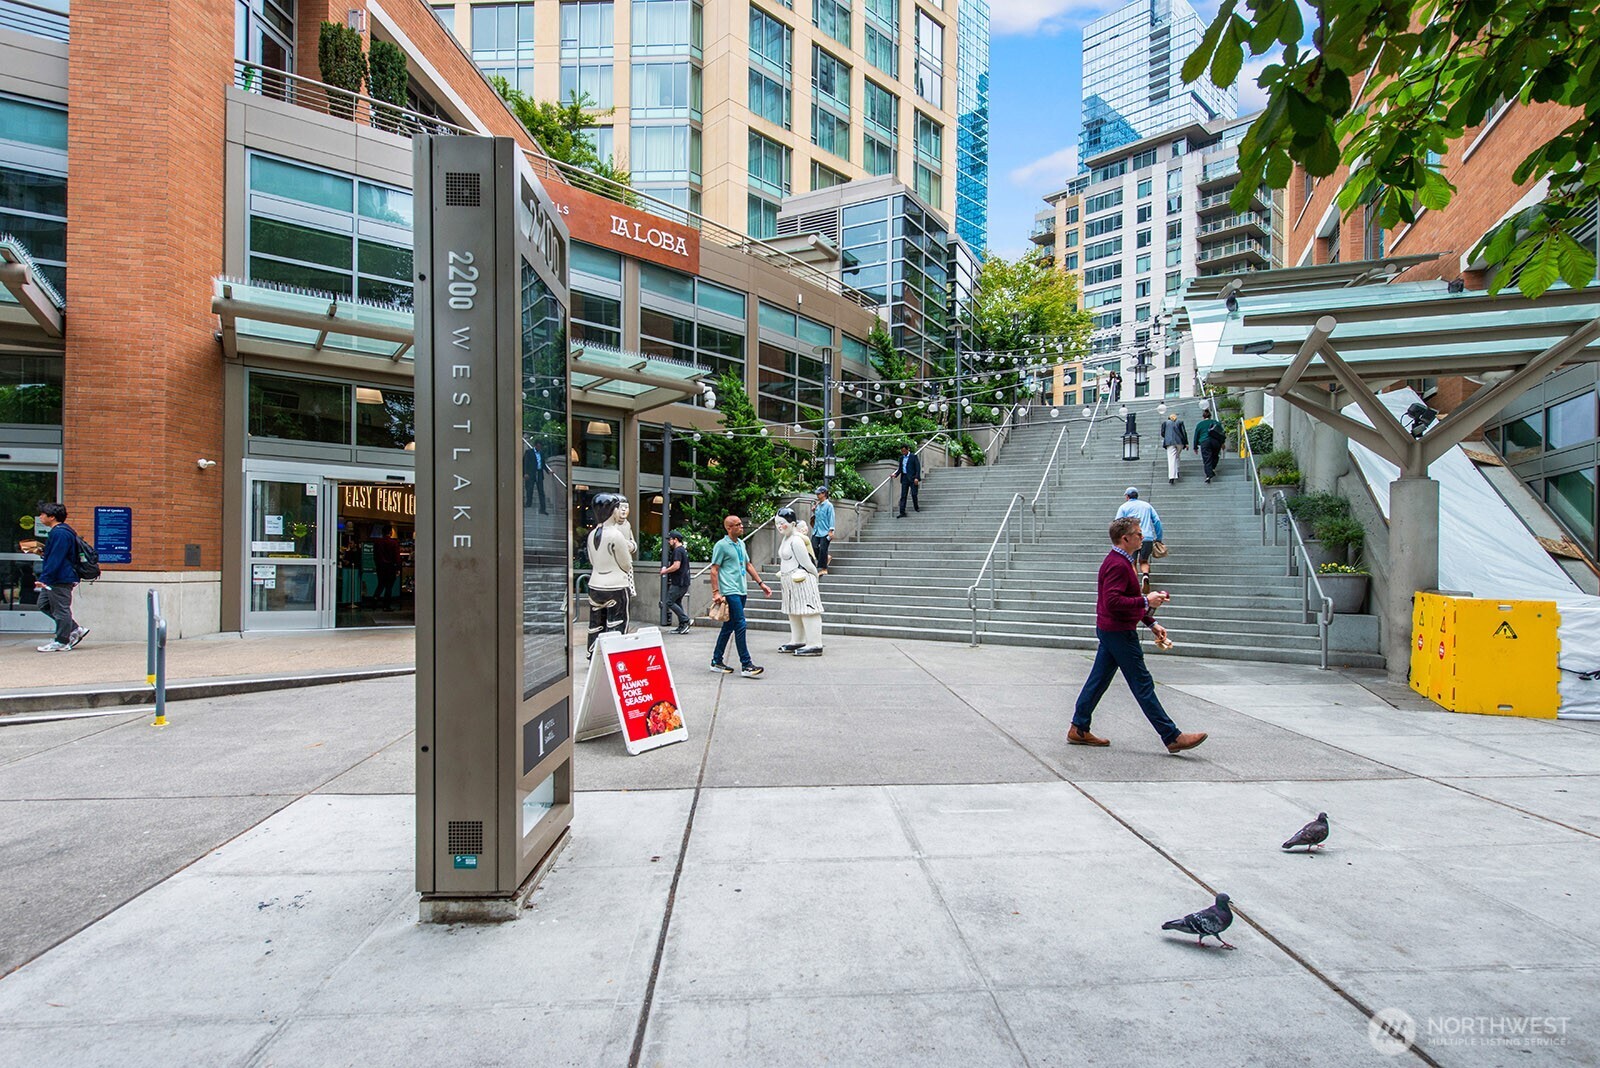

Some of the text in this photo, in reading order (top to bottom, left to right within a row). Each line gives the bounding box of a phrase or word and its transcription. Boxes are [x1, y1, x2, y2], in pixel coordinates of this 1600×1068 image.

[633, 222, 689, 257] LOBA
[448, 250, 479, 548] 2200 WESTLAKE
[345, 485, 373, 509] EASY
[376, 487, 402, 514] PEASY
[618, 674, 632, 683] IT'S
[622, 678, 649, 690] ALWAYS
[622, 688, 642, 698] POKE
[624, 694, 654, 706] SEASON
[538, 720, 545, 757] 1
